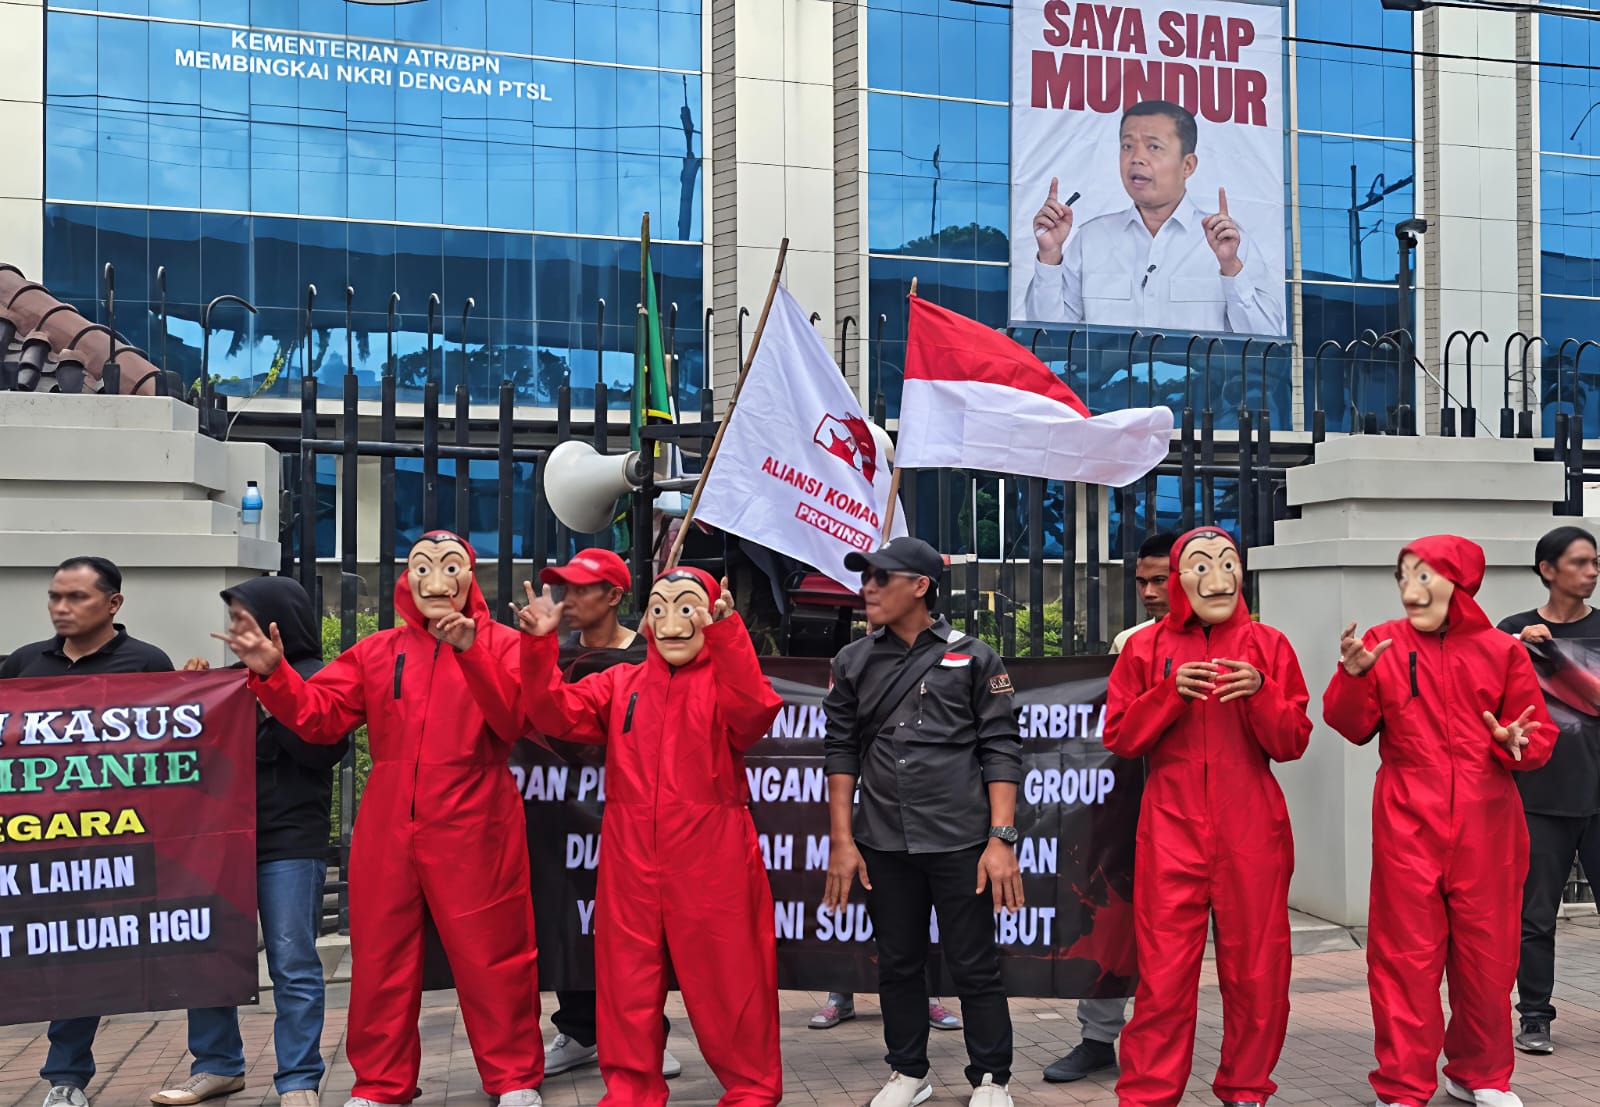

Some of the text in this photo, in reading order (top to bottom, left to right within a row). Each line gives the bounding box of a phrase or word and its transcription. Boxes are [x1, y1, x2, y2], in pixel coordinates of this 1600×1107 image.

[231, 30, 501, 74] KEMENTERIAN ATR/BPN
[1043, 0, 1255, 63] SAYA SIAP
[175, 49, 553, 102] MEMBINGKAI NKRI DENGAN PTSL
[1031, 50, 1268, 127] MUNDUR
[761, 456, 823, 497] ALIANSI
[798, 504, 871, 550] PROVINSI
[19, 703, 203, 745] KASUS
[1024, 767, 1115, 805] GROUP
[0, 808, 146, 843] GARA
[30, 855, 135, 895] LAHAN
[1014, 836, 1058, 874] AN
[26, 914, 140, 956] DILUAR
[149, 907, 211, 944] HGU
[815, 902, 873, 942] SUD
[993, 905, 1056, 945] BUT
